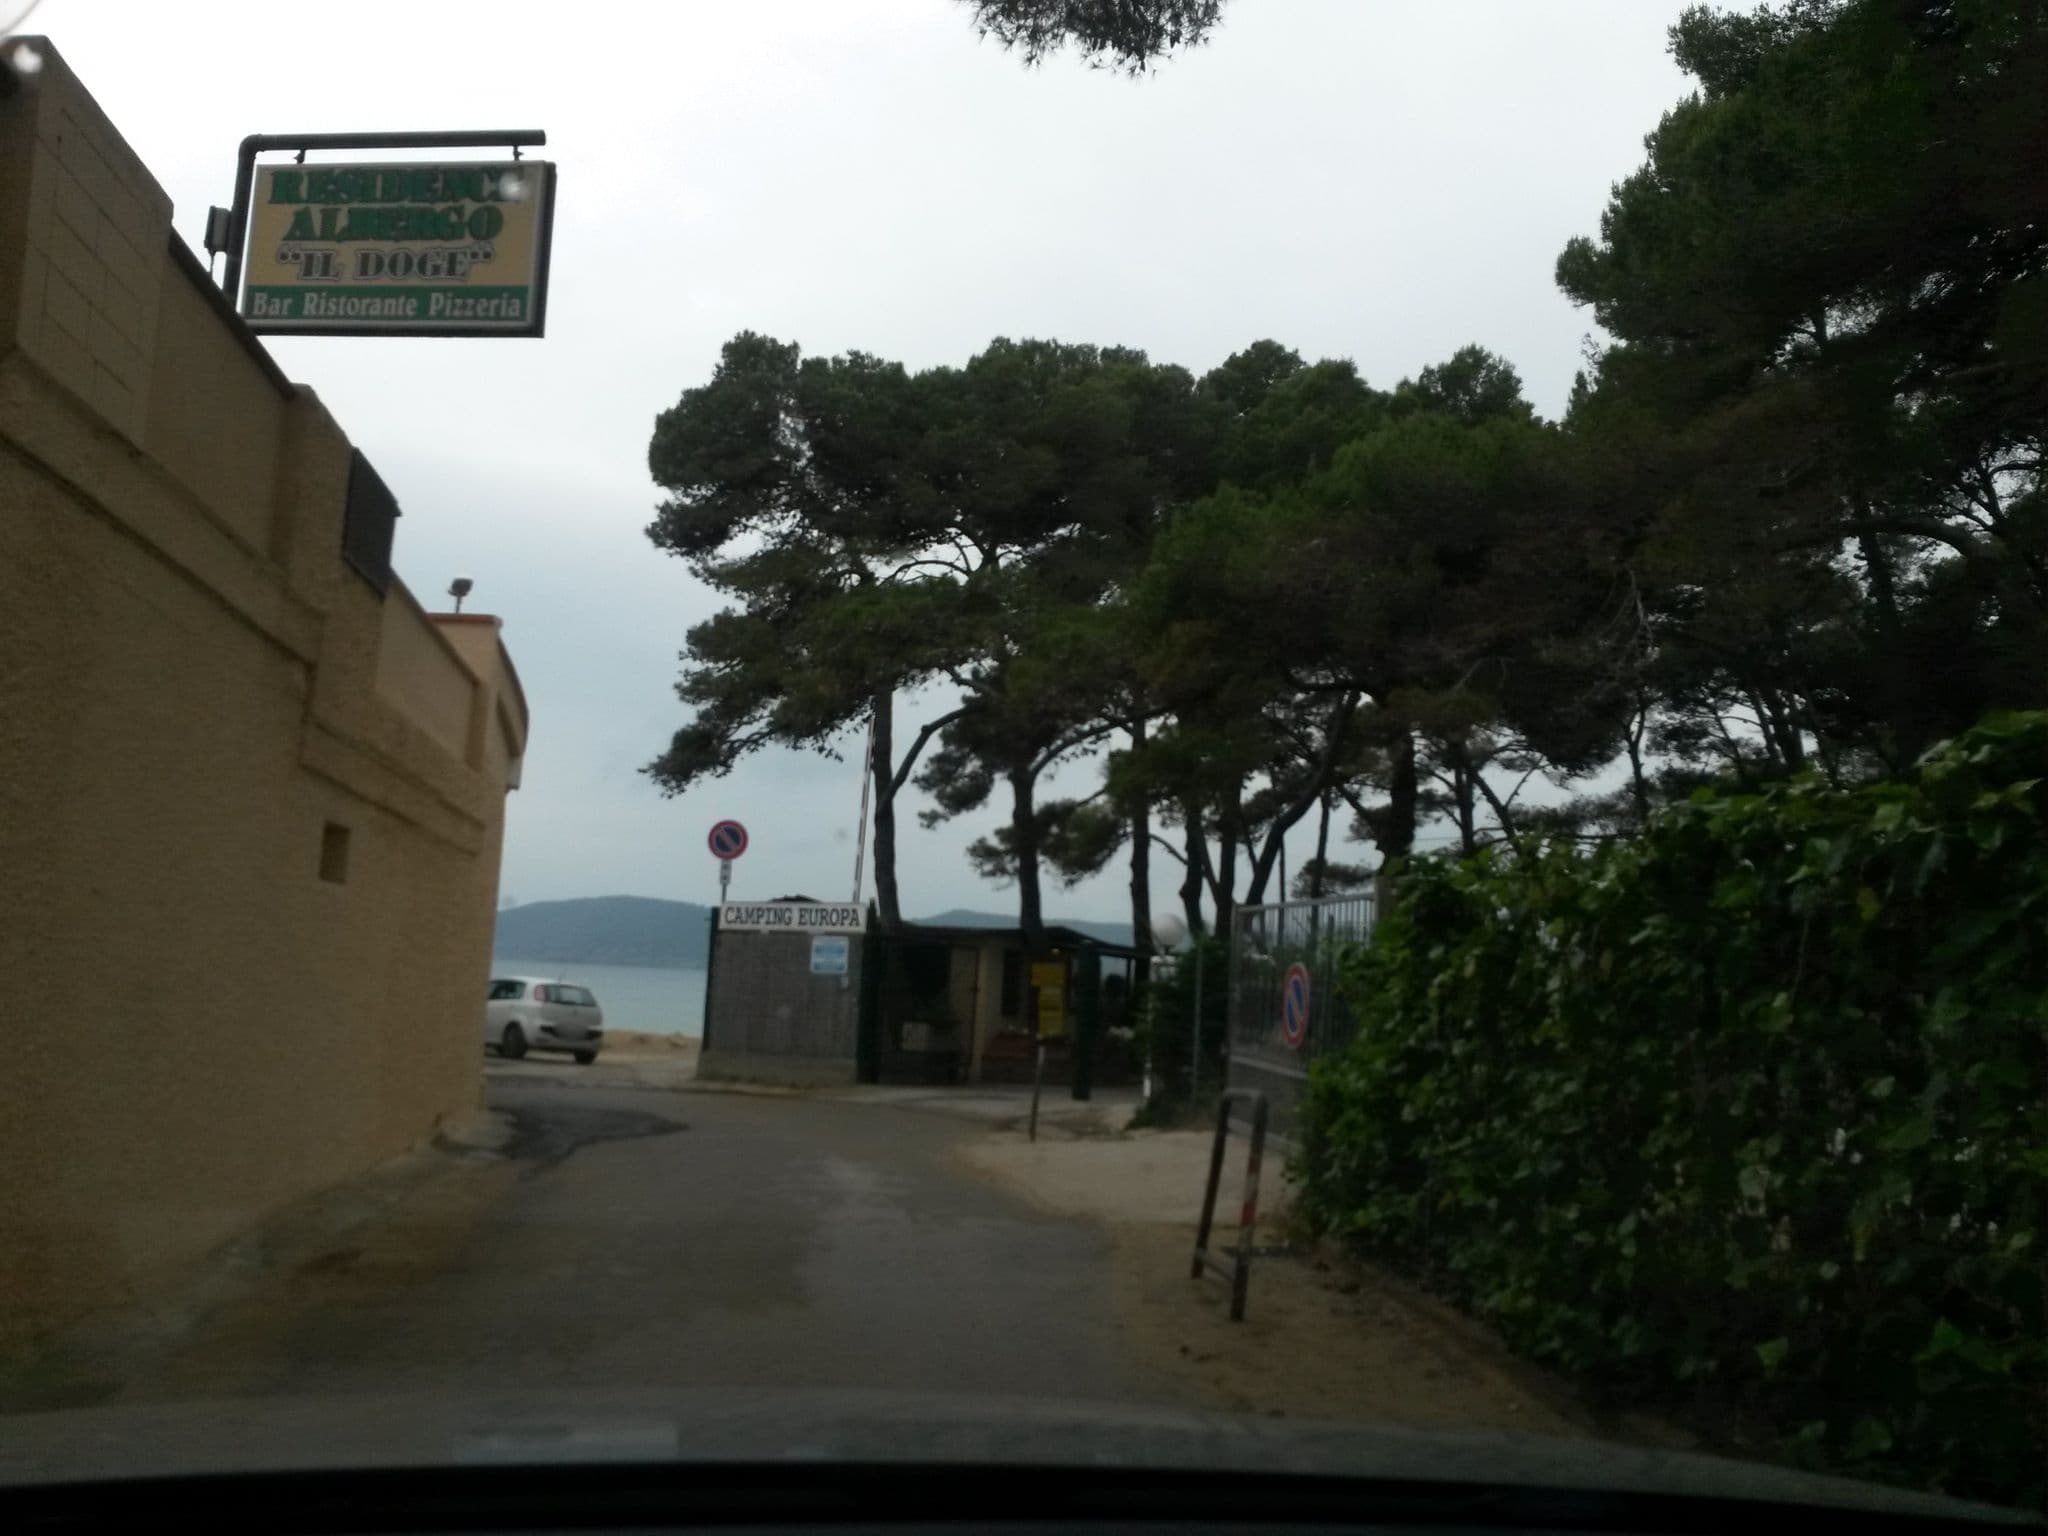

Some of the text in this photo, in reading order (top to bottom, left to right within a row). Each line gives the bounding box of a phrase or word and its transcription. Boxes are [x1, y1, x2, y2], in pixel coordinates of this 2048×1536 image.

[282, 205, 505, 241] ALBERGO
[252, 292, 521, 317] Bar Ristorante Pizzeria
[724, 907, 860, 928] CAMPING EUROPA
